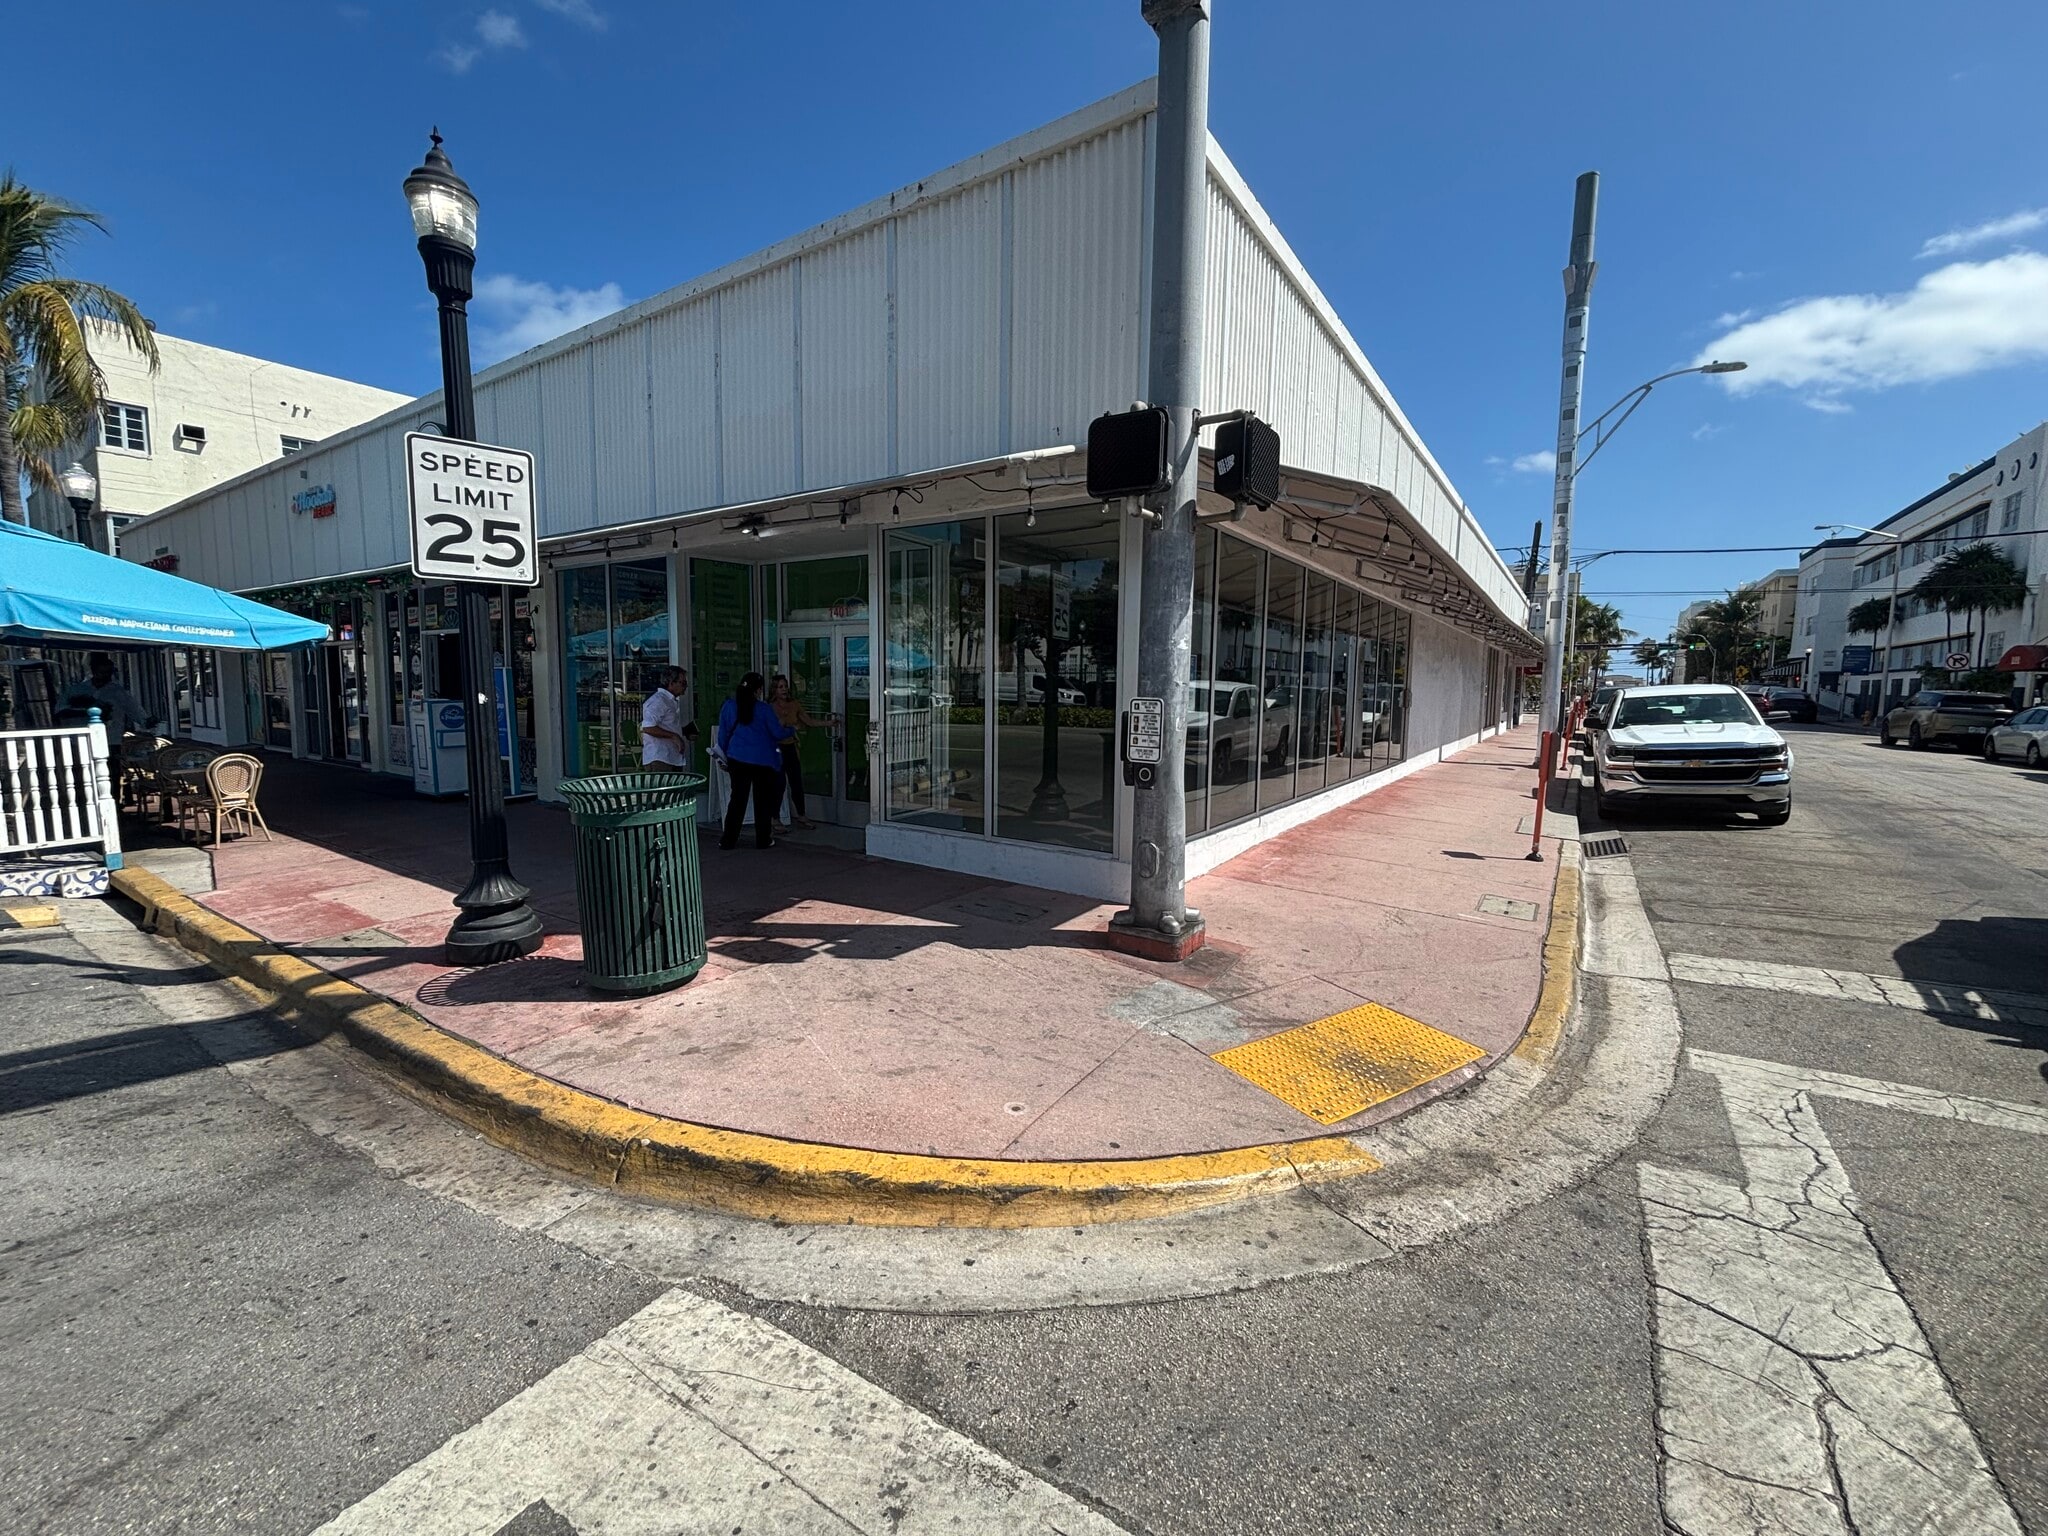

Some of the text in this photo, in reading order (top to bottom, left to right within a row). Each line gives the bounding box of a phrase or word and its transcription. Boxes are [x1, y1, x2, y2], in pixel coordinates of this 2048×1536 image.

[420, 451, 524, 483] SPEED
[433, 482, 514, 511] LIMIT
[423, 513, 526, 568] 25
[82, 614, 118, 626] PIZZERIA
[119, 618, 171, 632] NAPOLETANA
